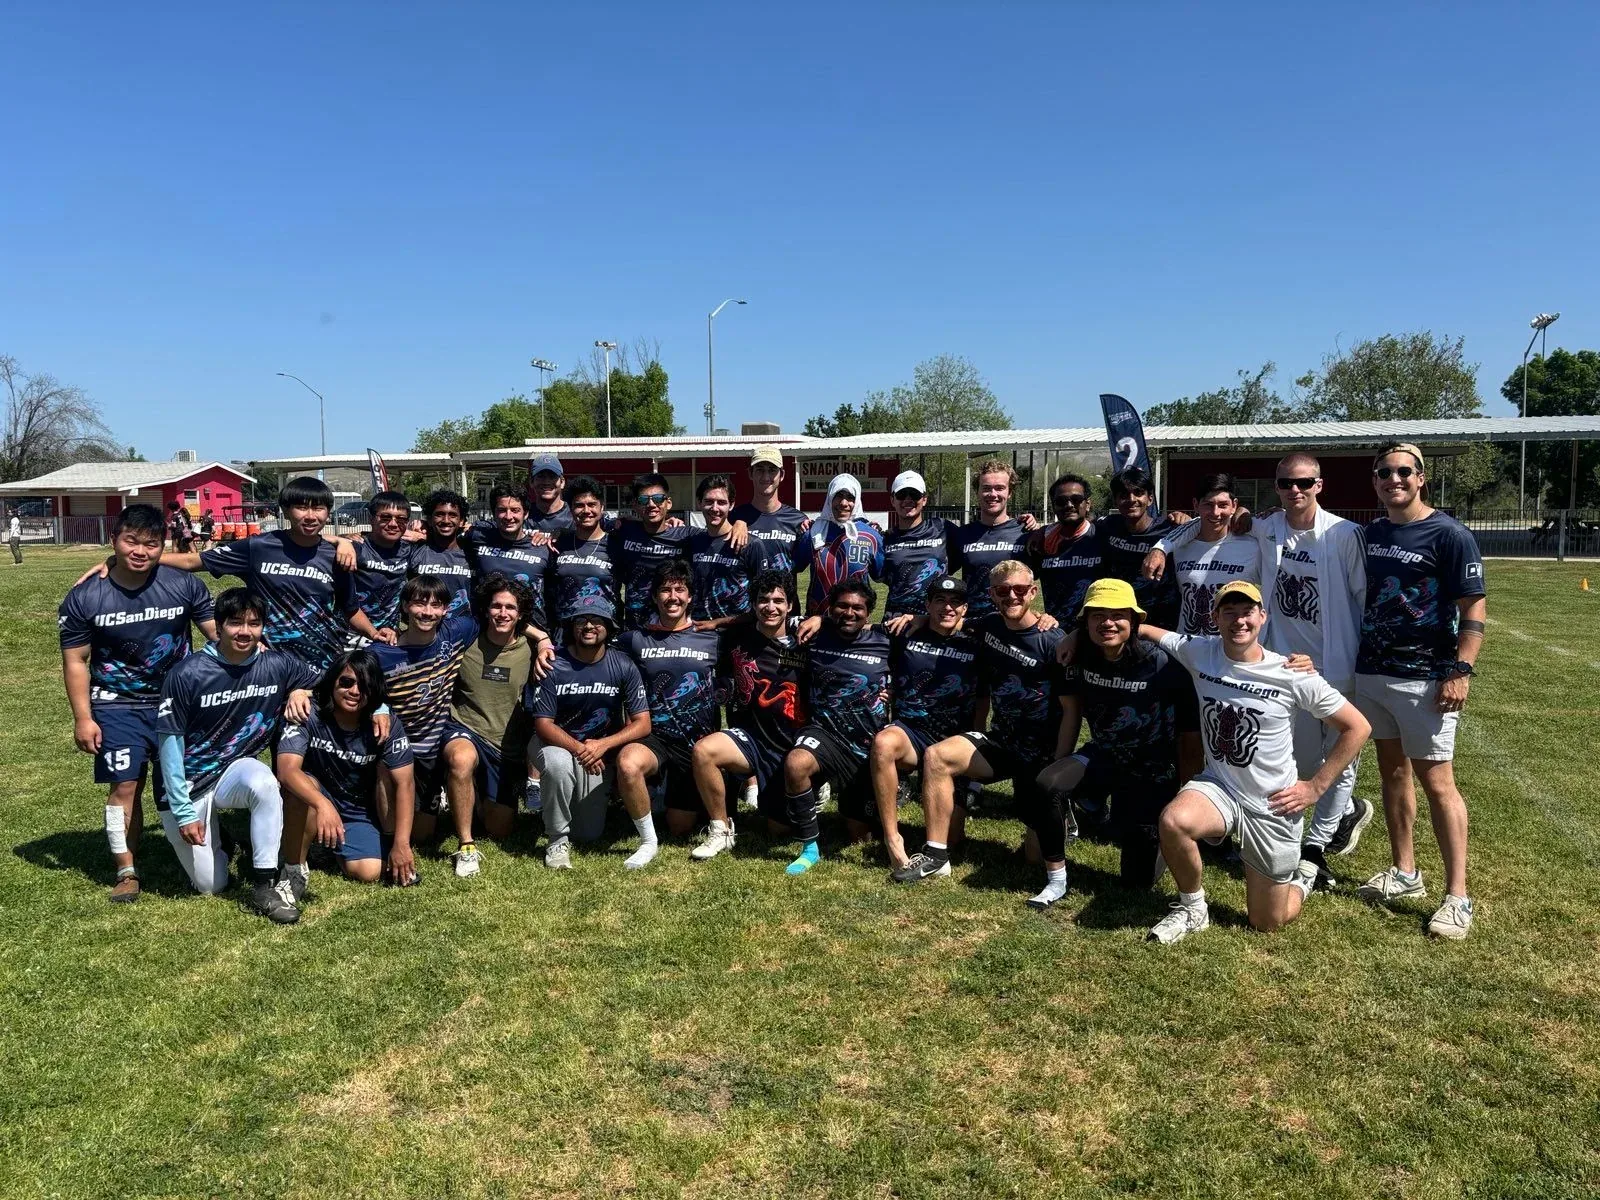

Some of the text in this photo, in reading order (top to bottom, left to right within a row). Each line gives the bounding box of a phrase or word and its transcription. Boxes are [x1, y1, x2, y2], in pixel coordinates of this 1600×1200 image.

[802, 462, 866, 476] SNACK BAR
[747, 529, 796, 543] SanDiego
[478, 545, 541, 564] UCSanDiego
[849, 545, 869, 565] 96
[1041, 555, 1102, 569] UCSanDiego
[1367, 543, 1423, 564] CSanDiego
[95, 606, 184, 627] UCSanDiego
[641, 647, 709, 660] UCSanDiego
[906, 640, 974, 662] UCSanDiego
[984, 631, 1037, 668] UCSanDiego
[415, 675, 446, 707] 27
[1083, 669, 1148, 693] UCSanDiego
[200, 684, 278, 708] UCSanDiego
[104, 747, 130, 771] 15
